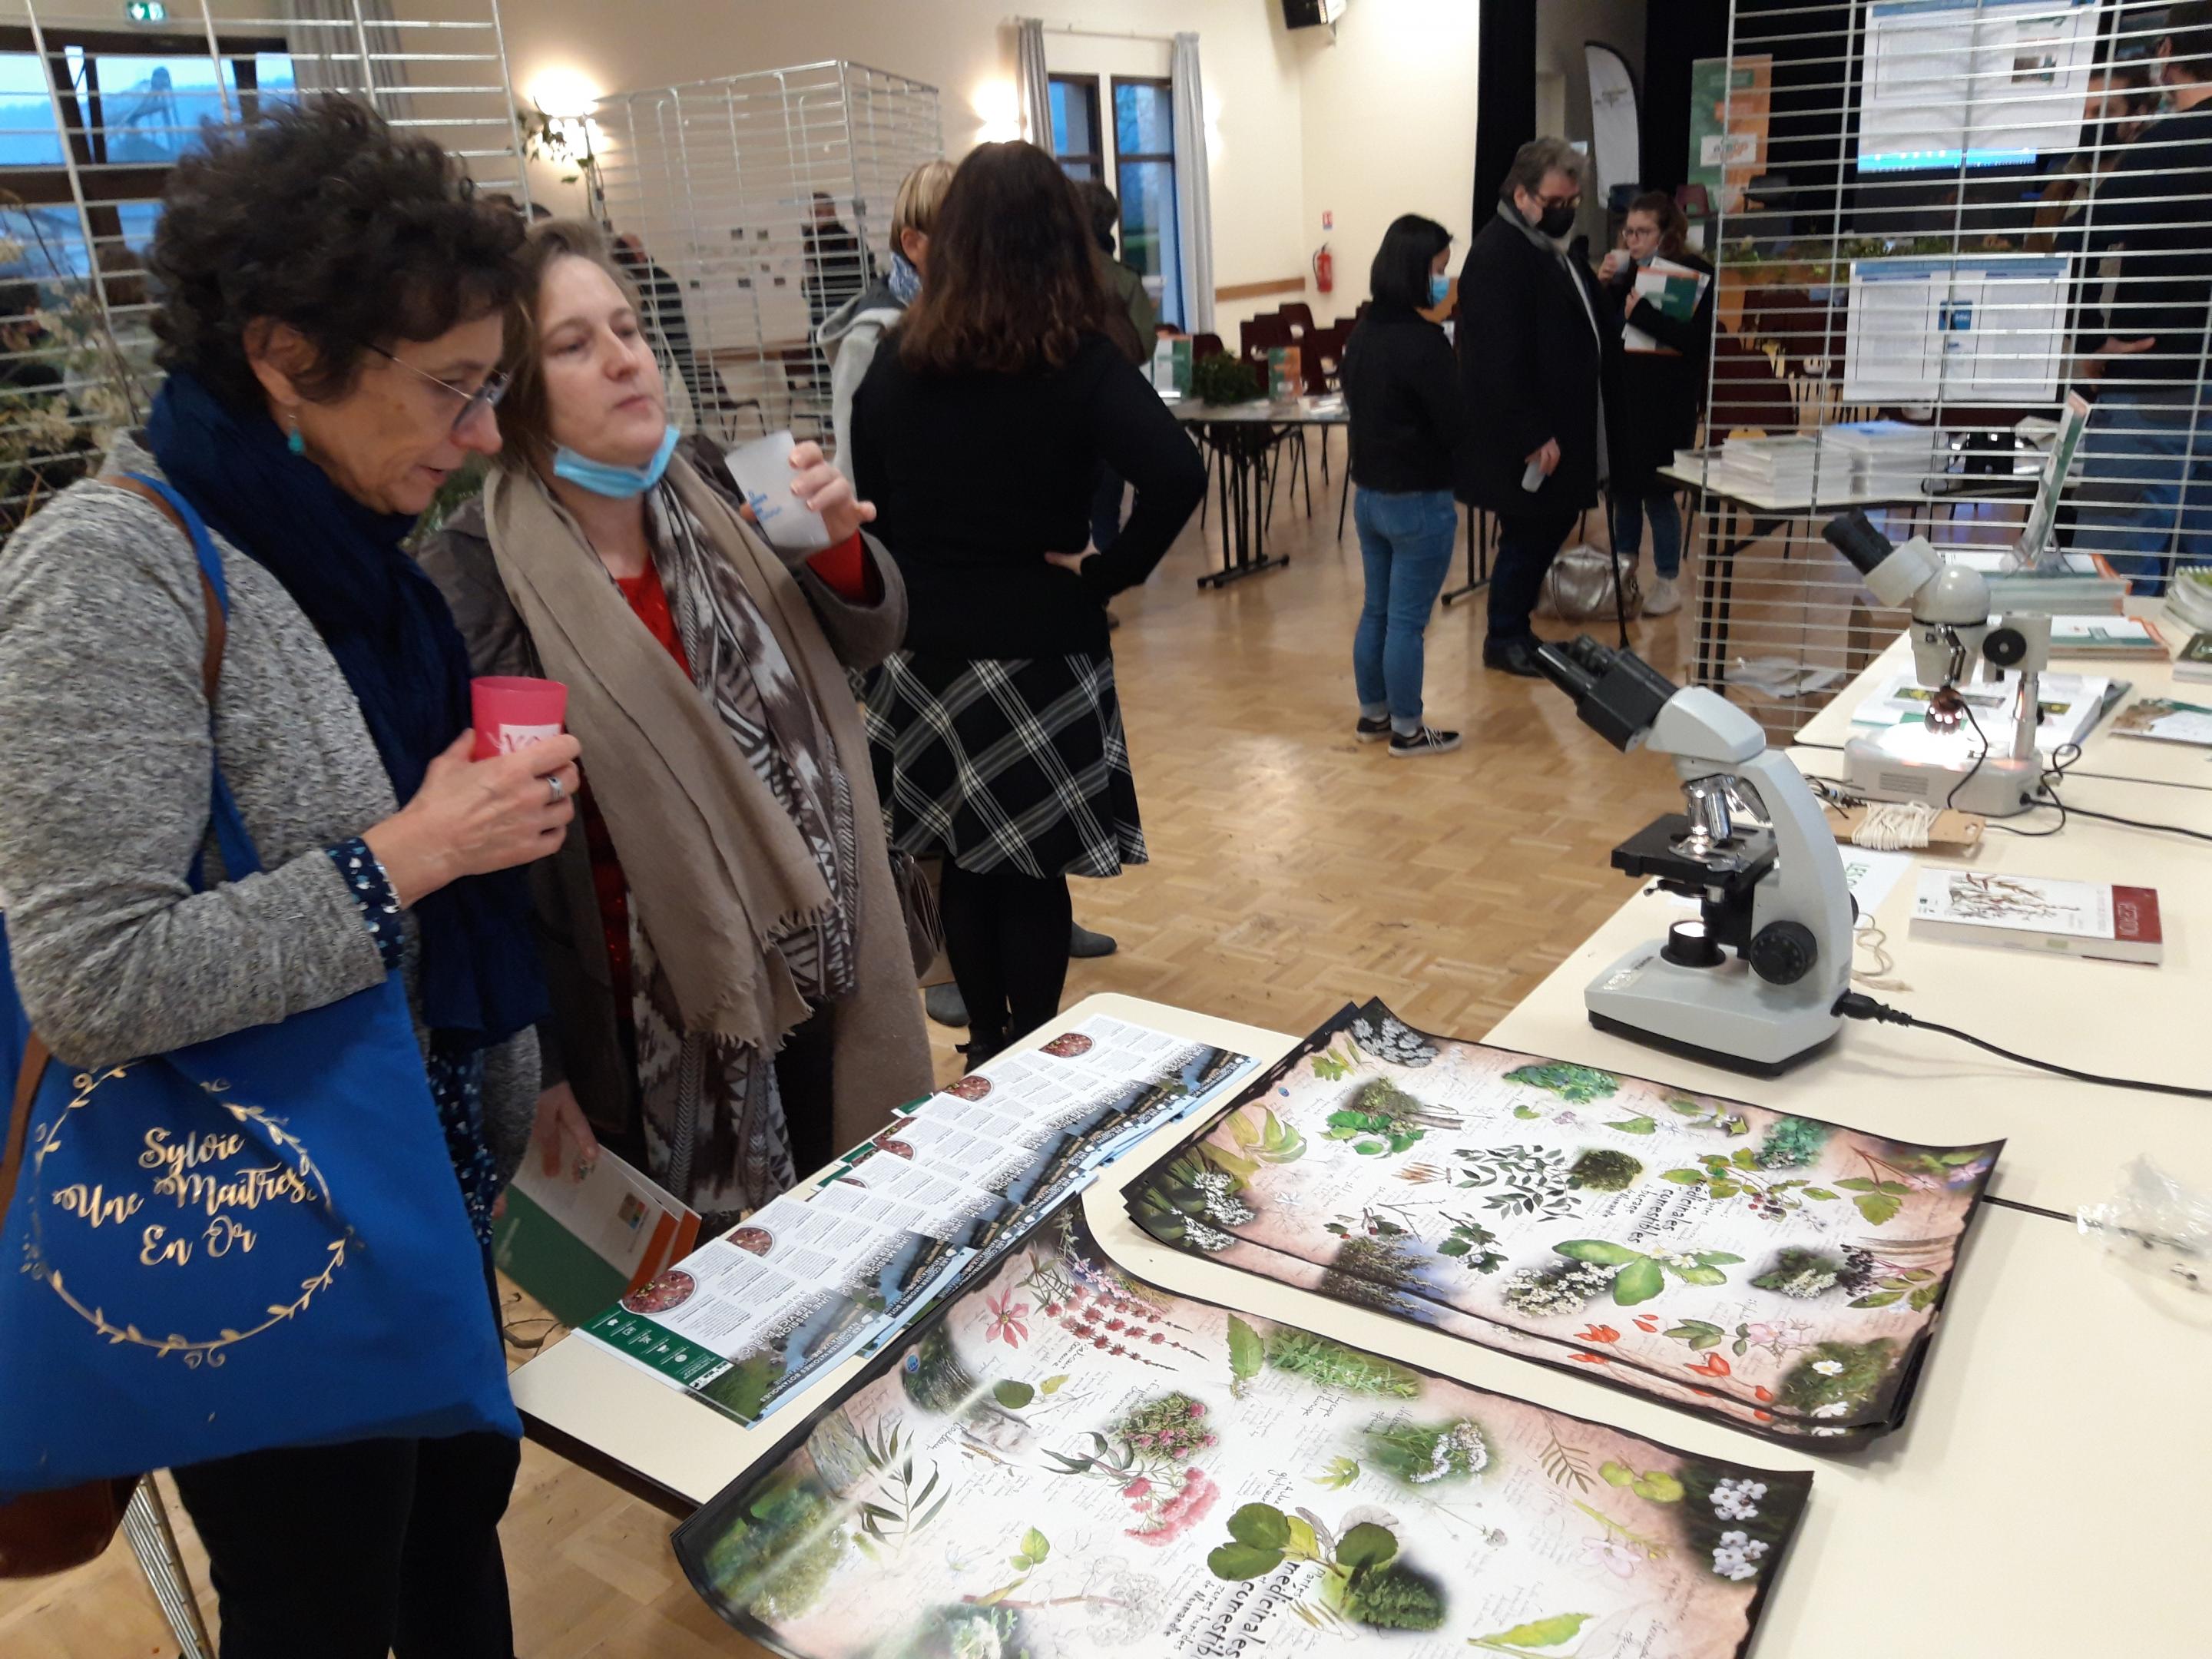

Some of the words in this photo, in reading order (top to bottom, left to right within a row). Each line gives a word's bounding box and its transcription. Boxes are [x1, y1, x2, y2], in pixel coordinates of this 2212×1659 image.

[139, 1127, 245, 1176] Sylvie
[53, 1184, 144, 1228] Une
[1627, 1188, 1674, 1244] comestibles
[140, 1225, 193, 1266] En
[202, 1215, 257, 1257] Or
[890, 1233, 905, 1244] DE
[950, 1220, 966, 1233] UNE
[894, 1235, 911, 1250] UNE
[862, 1243, 894, 1271] SERVICE
[865, 1250, 896, 1277] MISSION
[913, 1256, 944, 1283] NATIONAUX
[938, 1257, 951, 1268] LES
[836, 1270, 865, 1293] PUBLIC
[810, 1292, 826, 1303] DE
[811, 1295, 833, 1310] UNE
[772, 1302, 813, 1331] SERVICE
[774, 1310, 814, 1338] MISSION
[850, 1324, 865, 1334] LES
[740, 1330, 775, 1355] PUBLIC
[820, 1321, 859, 1350] NATIONAUX
[799, 1333, 853, 1373] CONSERVATOIRES
[758, 1373, 800, 1402] BOTANIQUES
[1202, 1579, 1215, 1589] de
[1293, 1567, 1326, 1599] Plantes
[1201, 1584, 1226, 1612] zones
[1225, 1561, 1300, 1659] médicinales
[1162, 1589, 1207, 1637] Normandie
[1173, 1614, 1211, 1652] humides
